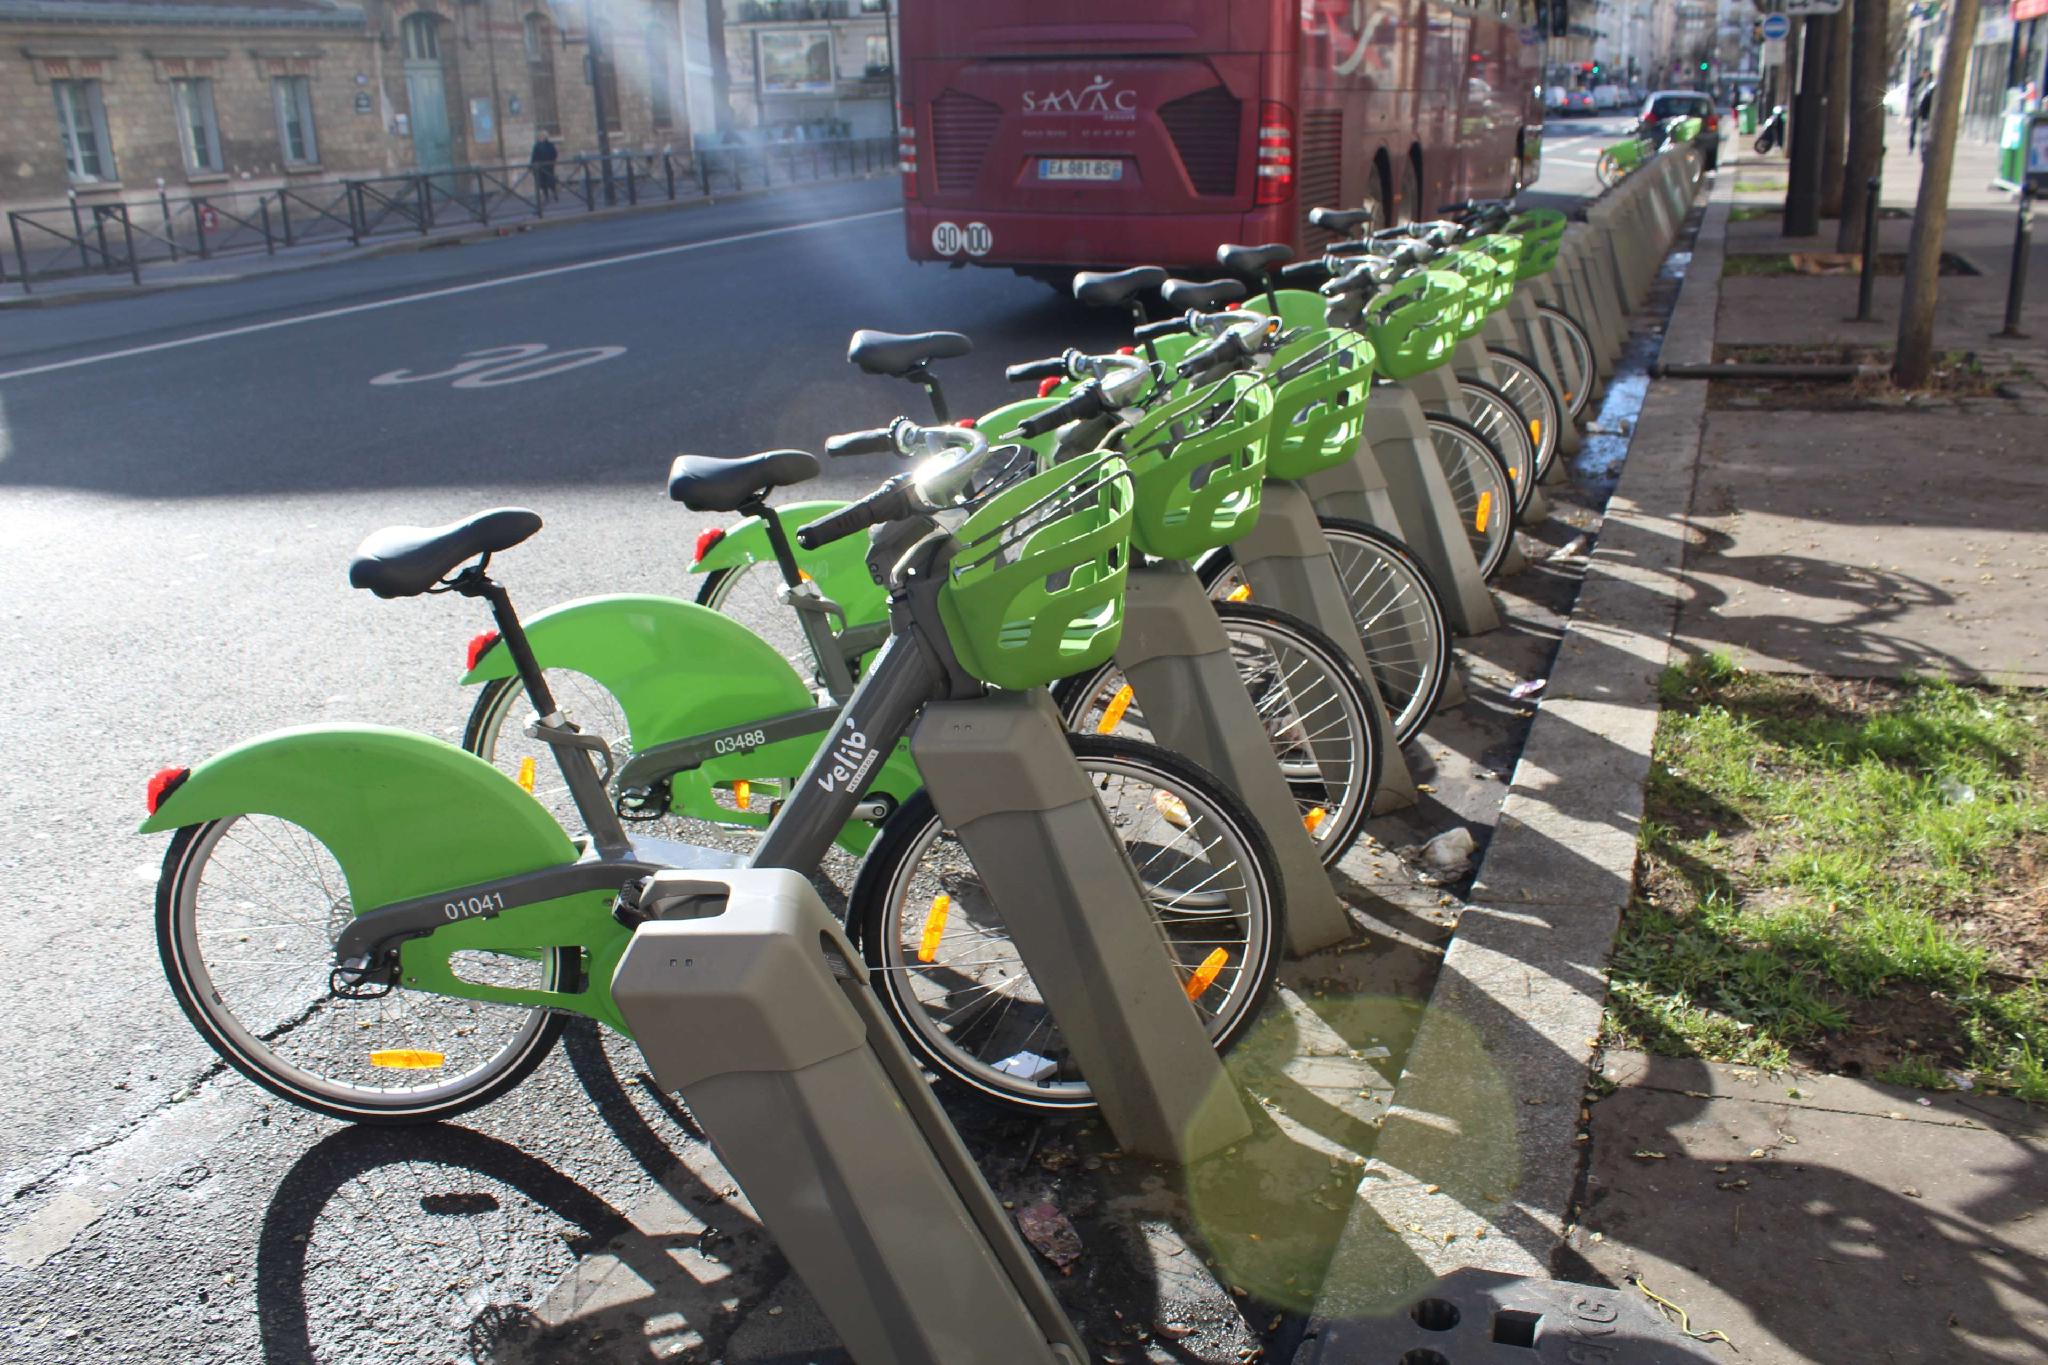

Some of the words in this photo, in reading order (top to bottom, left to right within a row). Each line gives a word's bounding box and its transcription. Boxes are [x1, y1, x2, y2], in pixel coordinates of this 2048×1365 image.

[1022, 79, 1137, 112] SAVAC
[937, 226, 958, 252] 90
[966, 226, 989, 252] 100
[368, 342, 628, 388] 30
[714, 729, 766, 754] 03488
[445, 892, 504, 920] 01041
